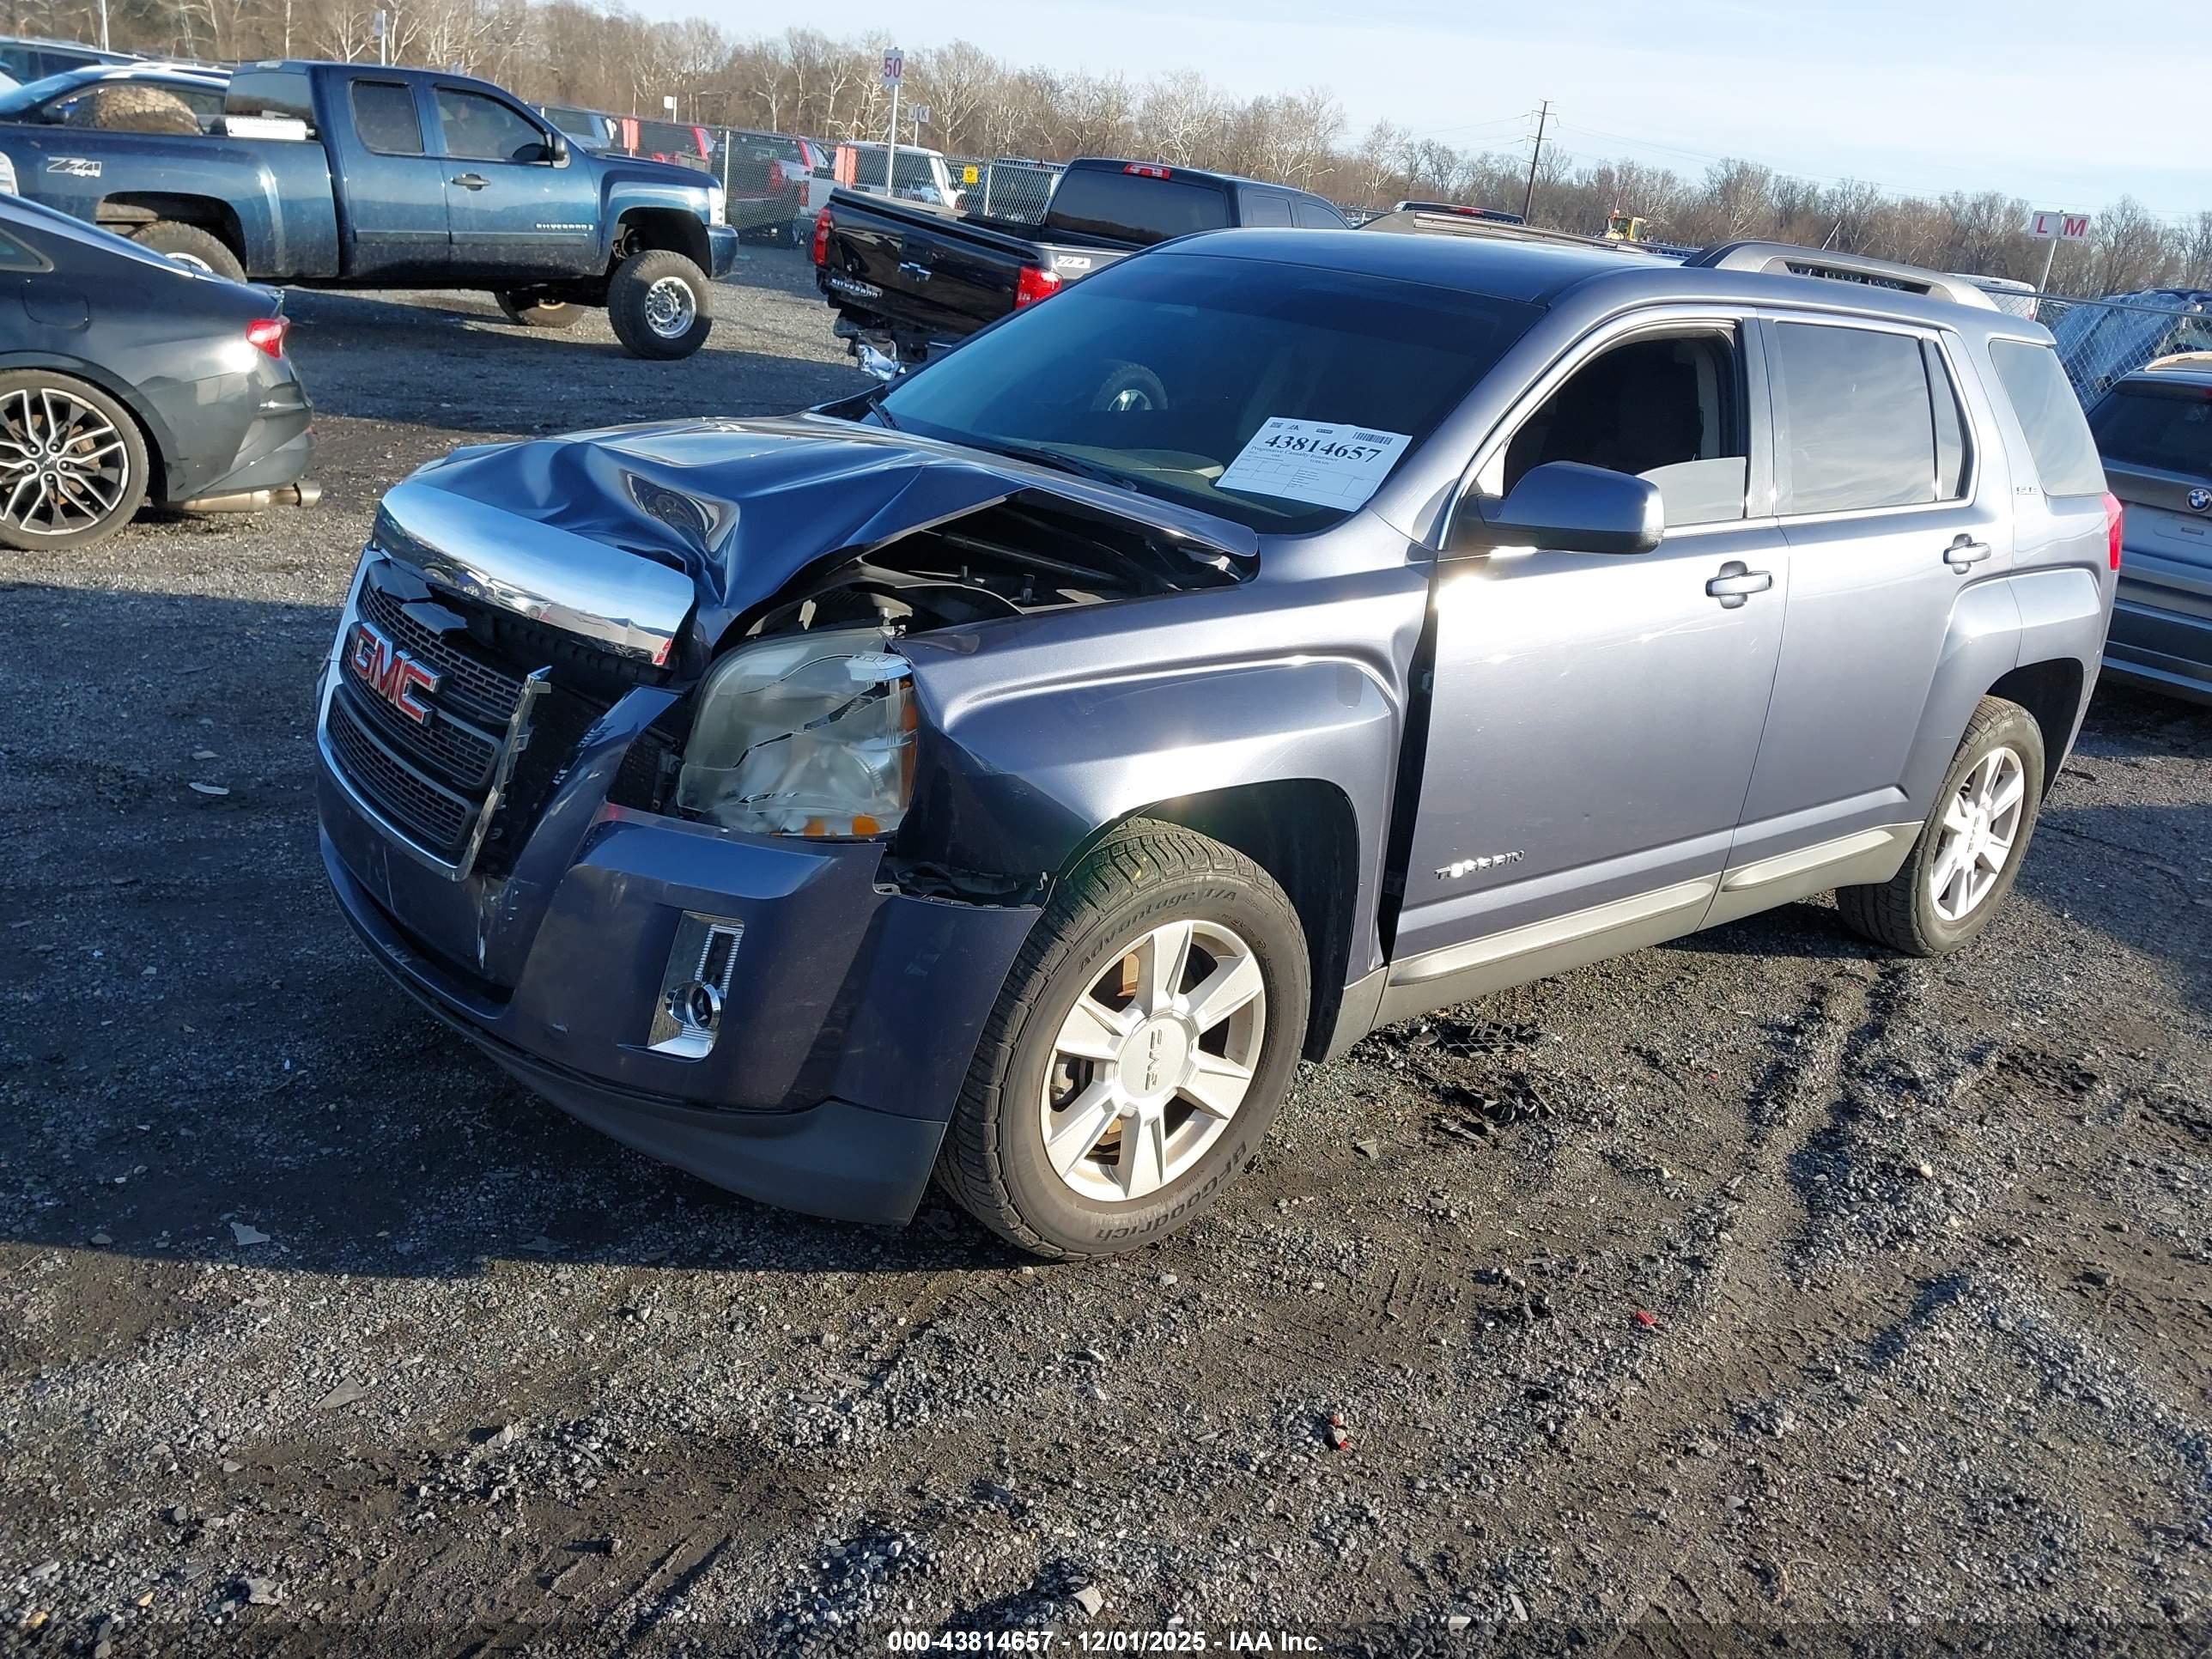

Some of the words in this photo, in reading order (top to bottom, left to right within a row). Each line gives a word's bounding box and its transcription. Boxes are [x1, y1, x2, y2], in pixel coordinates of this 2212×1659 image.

[884, 57, 902, 78] 50
[910, 106, 915, 118] J
[921, 107, 928, 120] K
[2036, 216, 2048, 234] L
[2063, 217, 2087, 237] M
[1265, 434, 1382, 463] 43814657
[352, 622, 441, 725] GMC
[1434, 850, 1525, 879] TRRAIN
[1204, 888, 1237, 902] T/A
[1145, 1029, 1163, 1091] GMC
[1095, 1141, 1247, 1242] BFGoodrich
